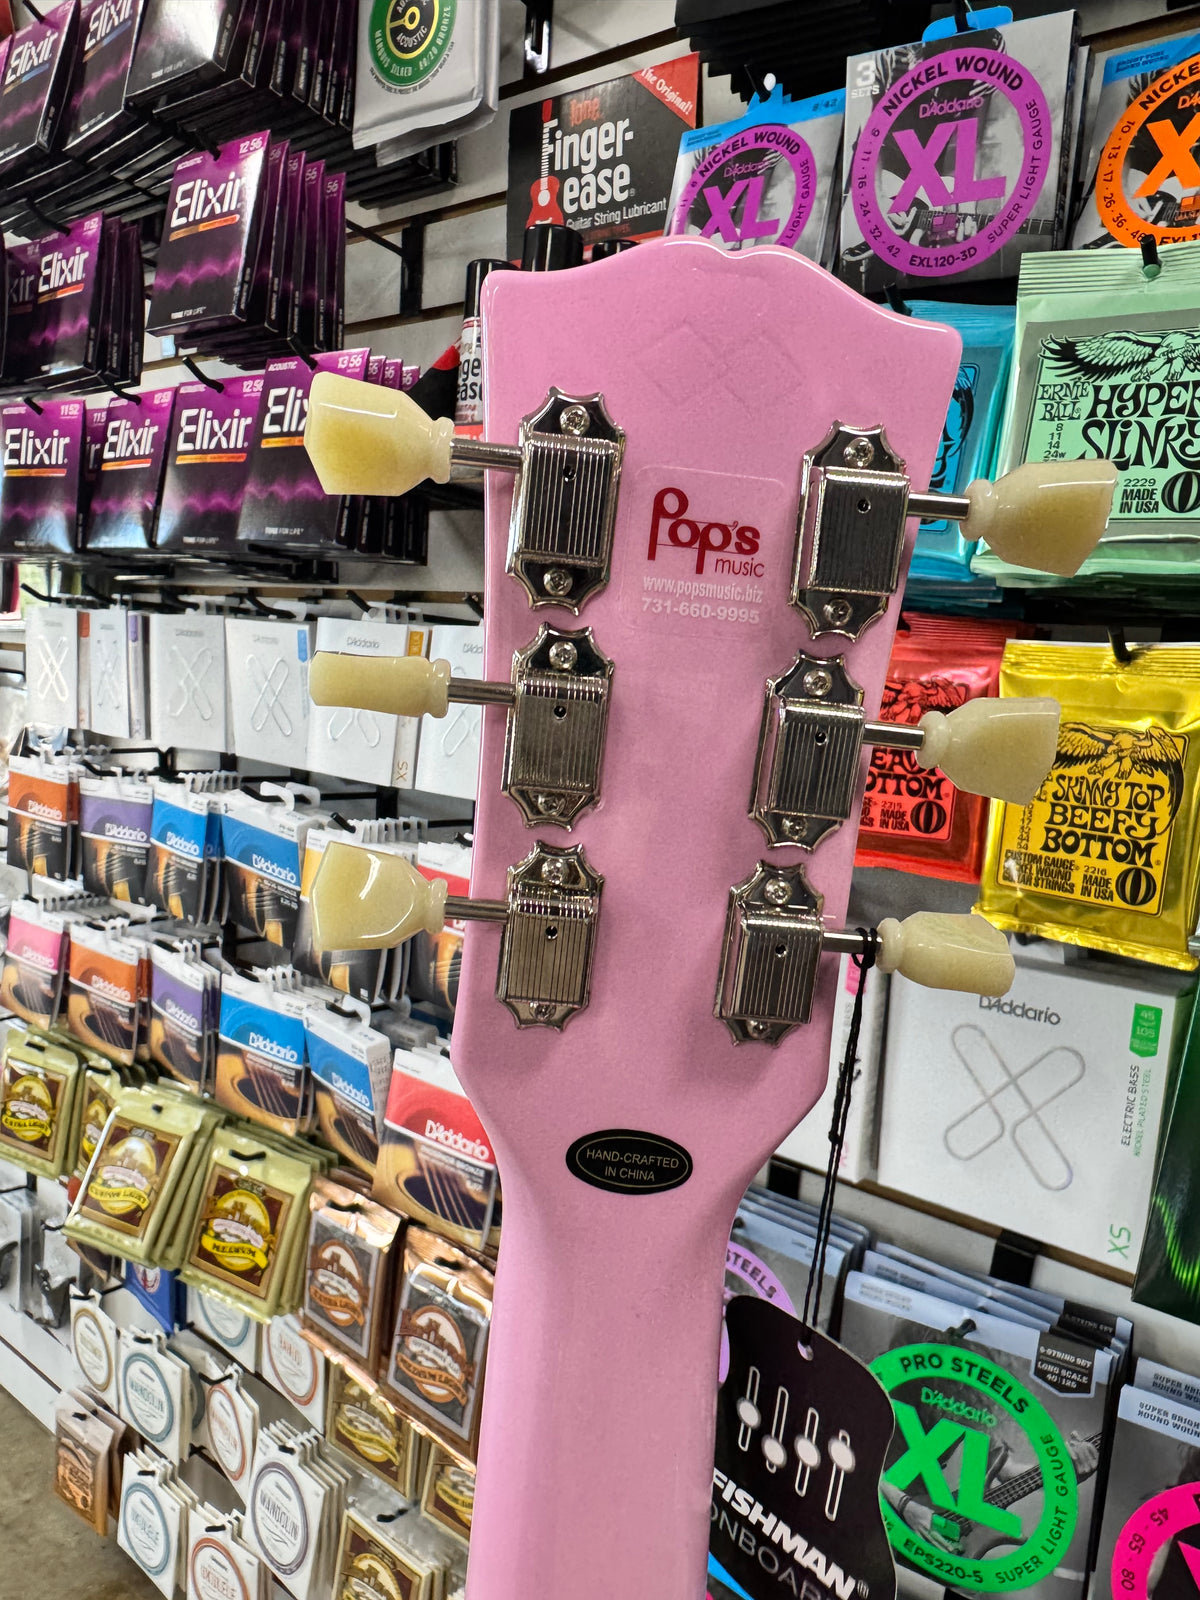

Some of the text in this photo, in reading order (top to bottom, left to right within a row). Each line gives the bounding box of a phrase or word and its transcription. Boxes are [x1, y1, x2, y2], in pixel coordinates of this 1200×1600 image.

[4, 29, 58, 85] Elixir
[855, 60, 877, 87] 3
[640, 68, 693, 116] The Original!
[851, 85, 880, 99] SETS
[882, 55, 1024, 117] NICKEL WOUND
[1138, 61, 1200, 111] NICKE
[700, 136, 750, 178] NICKEL
[754, 131, 801, 156] WOUND
[887, 117, 1007, 214] XL
[987, 98, 1043, 244] SUPER LIGHT GAUGE
[1131, 112, 1200, 199] X
[170, 171, 247, 228] Elixir
[562, 163, 631, 214] ease
[785, 157, 811, 240] LIGHT GAUGE
[593, 207, 621, 226] String
[622, 197, 668, 219] Lubricant
[700, 174, 781, 243] XL
[859, 200, 871, 218] 24
[869, 225, 883, 242] 32
[886, 243, 901, 259] 42
[38, 246, 90, 293] Elixir
[908, 246, 978, 268] EXL120-3D
[1038, 377, 1091, 401] ERNIE
[177, 407, 252, 452] Elixir
[1038, 400, 1081, 422] BALL
[1055, 423, 1064, 432] 8
[3, 427, 71, 466] Elixir
[103, 417, 158, 460] Elixir
[1049, 432, 1062, 441] 11
[1122, 488, 1158, 501] MADE
[1124, 478, 1156, 488] 2229
[1119, 501, 1159, 514] IN USA
[647, 487, 761, 575] Pop's
[714, 557, 765, 578] music
[642, 574, 763, 604] www.popsmusic.biz
[641, 596, 760, 625] 731-660-9995
[865, 771, 946, 801] OTTOM
[1051, 773, 1122, 808] SKINNY
[1125, 781, 1165, 813] TOP
[879, 818, 910, 832] IN USA
[880, 808, 907, 821] MADE
[1045, 802, 1160, 841] BEEFY
[1039, 826, 1160, 869] BOTTOM
[1043, 856, 1076, 871] GAUGE
[252, 853, 297, 884] D'Addario
[1033, 876, 1075, 894] STRINGS
[1035, 866, 1072, 882] WOUND
[1082, 873, 1113, 890] MADE
[1080, 884, 1114, 902] IN USA
[249, 1031, 298, 1064] D'Addario
[1120, 1063, 1140, 1147] ELECTRIC BASS
[425, 1119, 489, 1160] D'Addario
[586, 1148, 680, 1169] HAND-CRAFTED
[604, 1166, 656, 1182] IN CHINA
[1107, 1223, 1132, 1259] XS
[899, 1352, 1030, 1414] PRO STEELS
[1037, 1360, 1089, 1384] LONG SCALE
[920, 1386, 998, 1428] D'Addario
[1137, 1409, 1200, 1439] ROUND WOUN
[1138, 1401, 1200, 1430] SUPER BRIGH
[882, 1398, 1022, 1539] XL
[259, 1489, 300, 1543] MANDOLIN
[994, 1433, 1069, 1585] SUPER LIGHT GAUGE
[713, 1466, 857, 1600] FISHMAN
[1121, 1508, 1169, 1592] 45 65 80
[902, 1537, 985, 1585] EPS220-5
